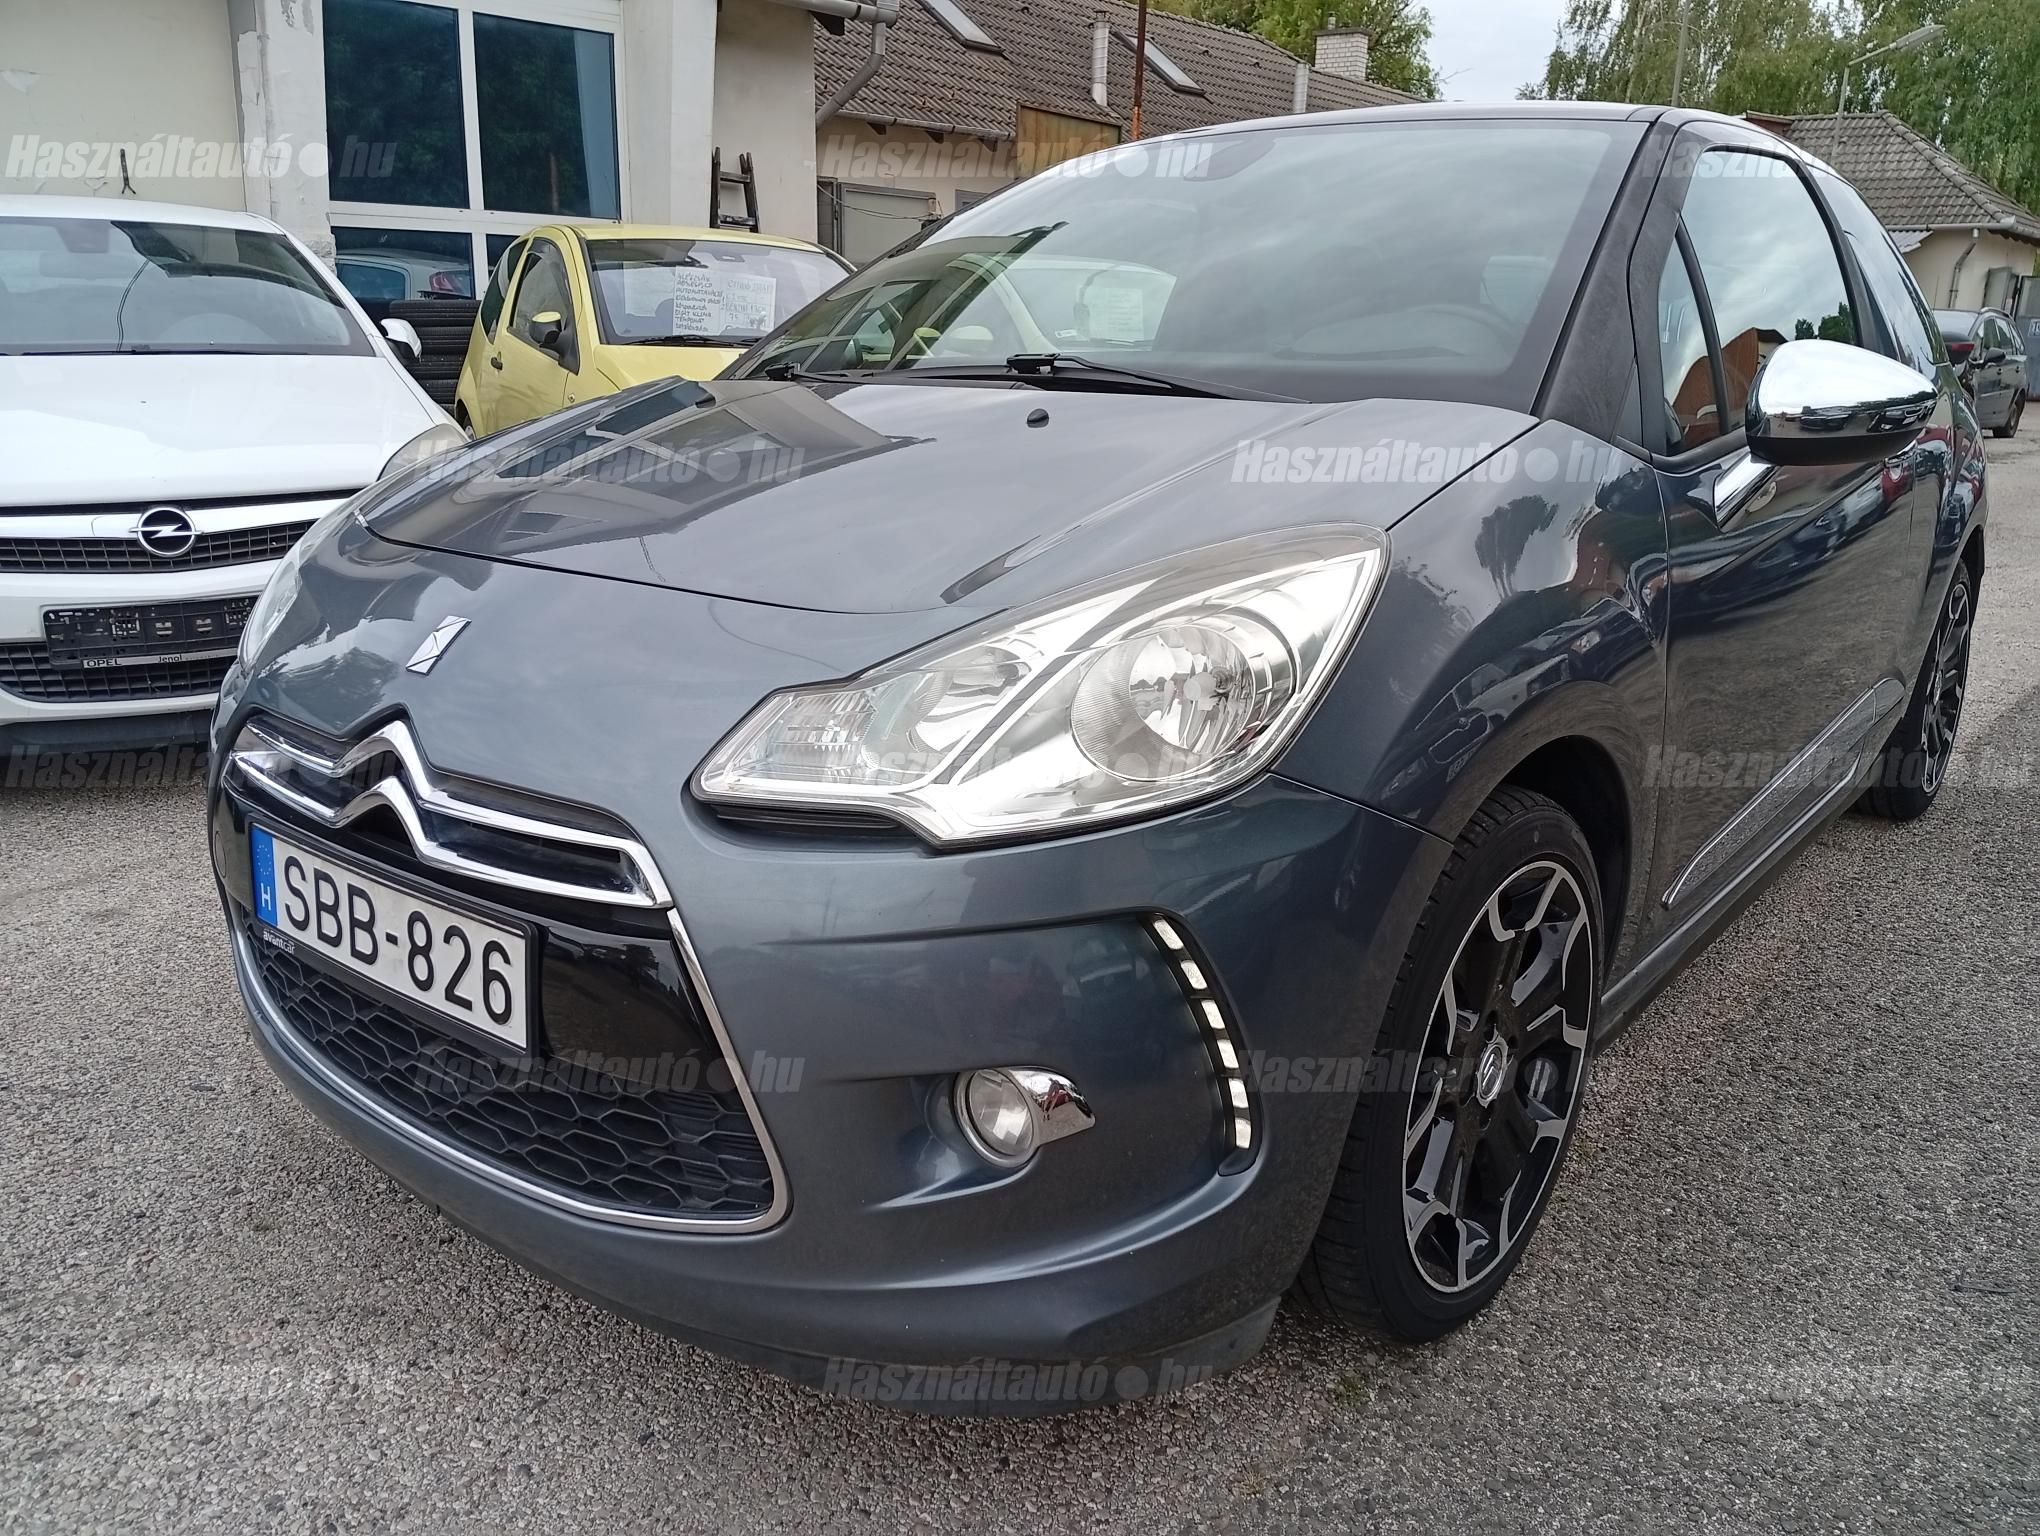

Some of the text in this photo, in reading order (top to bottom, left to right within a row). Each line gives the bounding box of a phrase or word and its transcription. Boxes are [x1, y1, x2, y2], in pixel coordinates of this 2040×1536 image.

[86, 658, 122, 668] OPEL
[260, 882, 272, 912] H
[284, 855, 513, 1026] SBB-826
